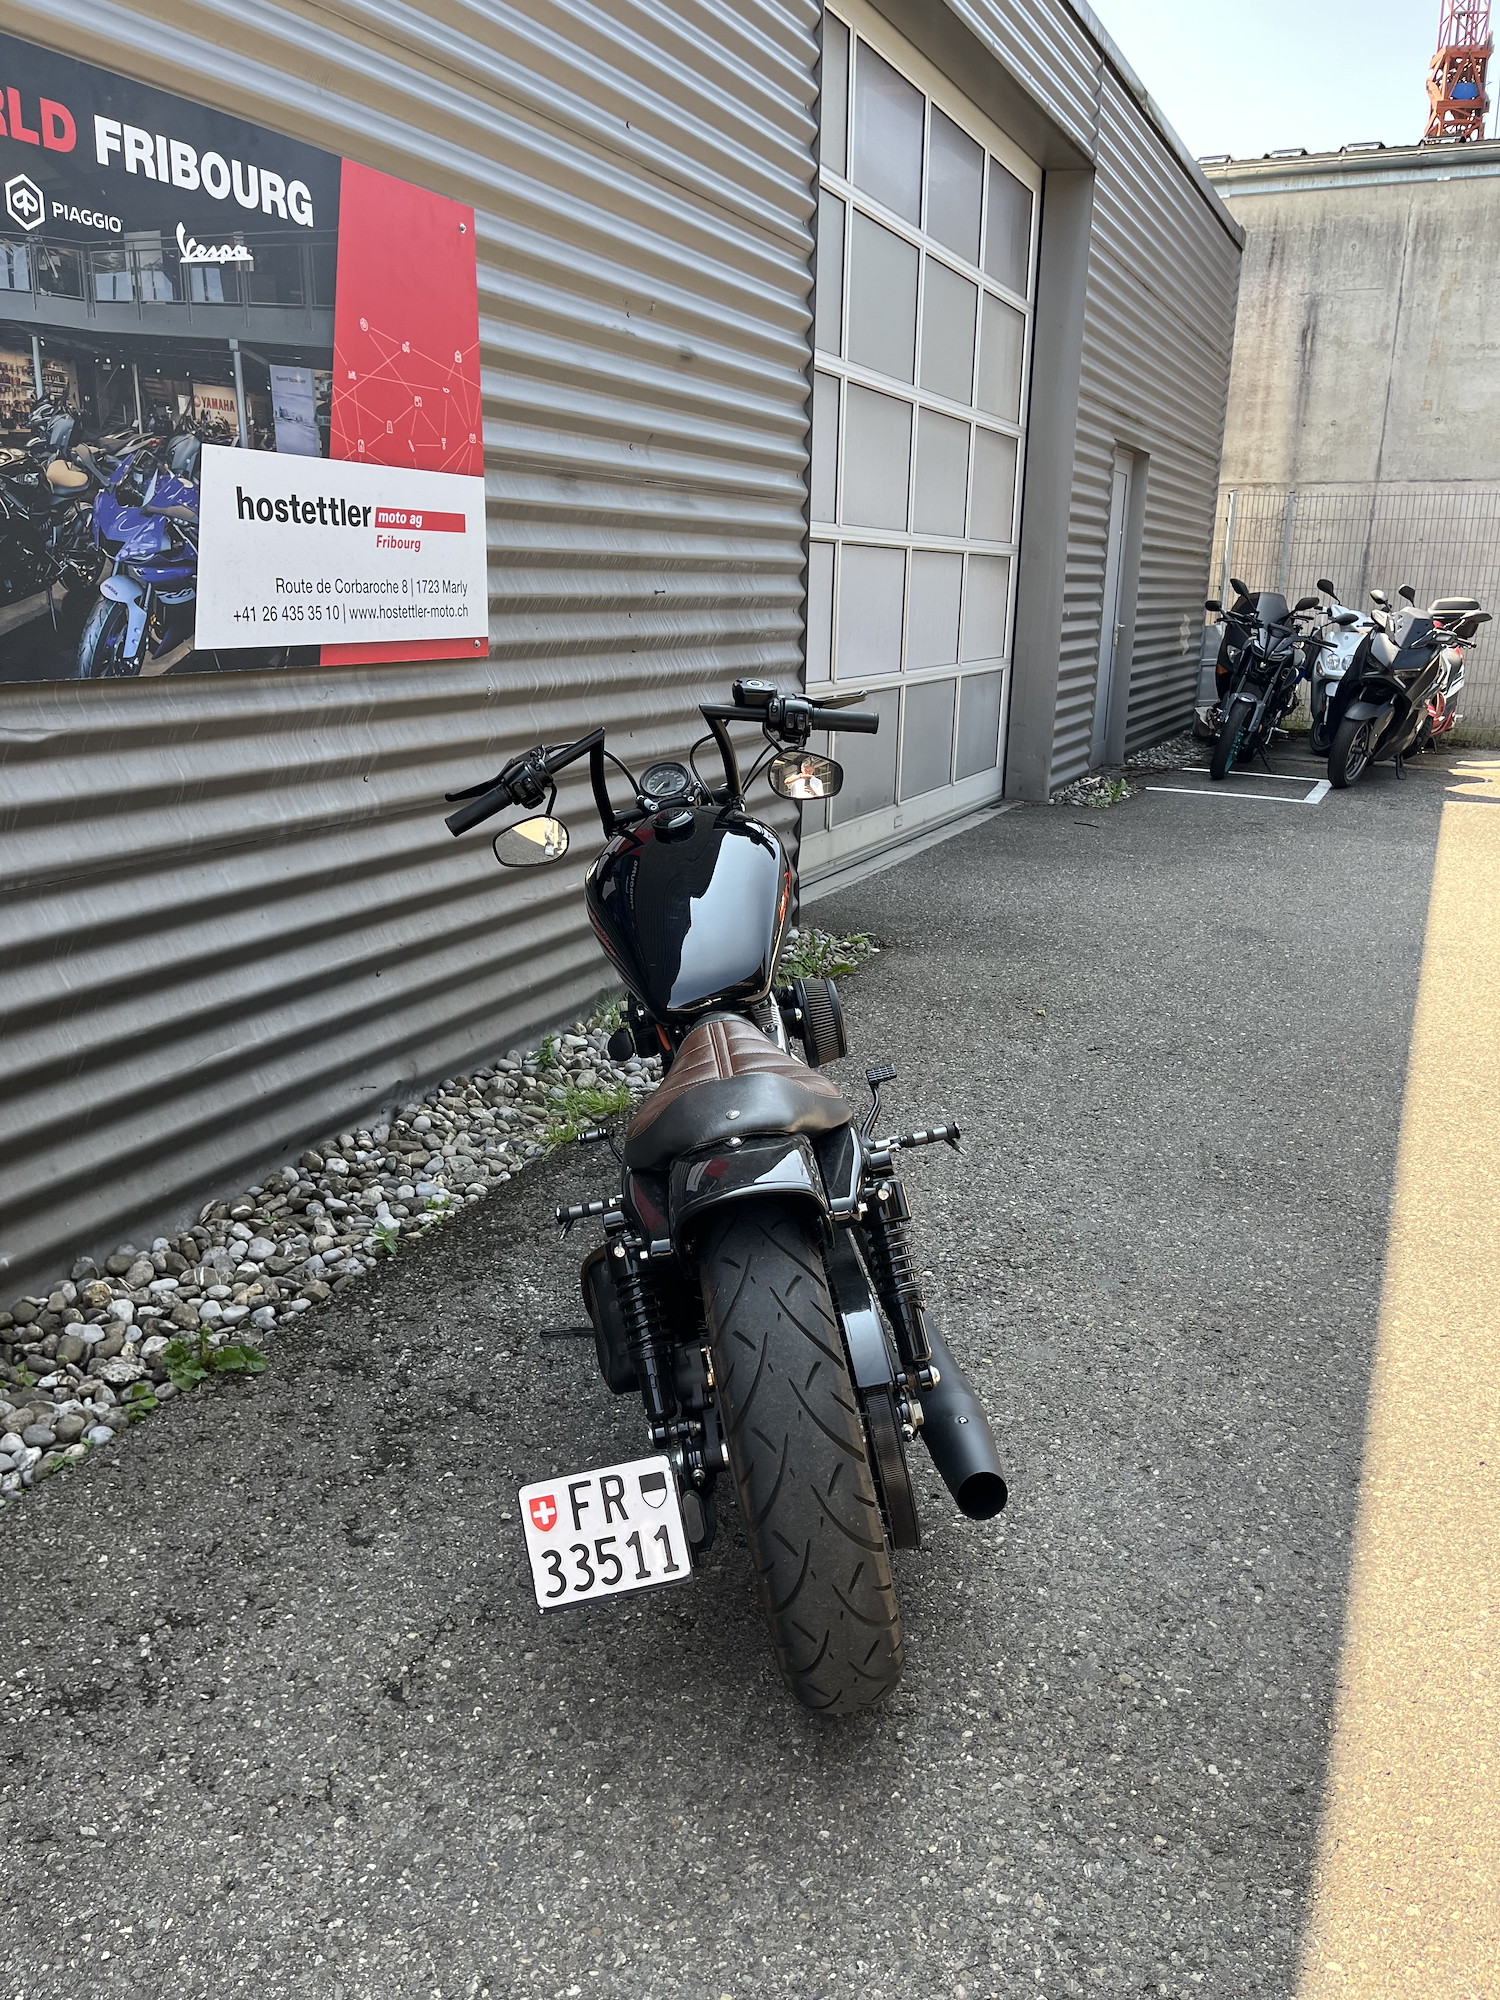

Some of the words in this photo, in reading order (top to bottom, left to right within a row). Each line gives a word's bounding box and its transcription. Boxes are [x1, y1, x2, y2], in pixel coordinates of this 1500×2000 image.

[0, 86, 77, 153] LD
[94, 114, 314, 228] FRIBOURG
[52, 201, 122, 233] PIAGGIO
[176, 221, 254, 264] Vespa
[201, 396, 235, 413] YAMAHA
[236, 486, 371, 527] hostettler
[378, 511, 406, 525] moto
[409, 514, 423, 528] ag
[376, 535, 421, 552] Fribourg
[275, 577, 313, 594] Route
[316, 578, 331, 594] de
[335, 578, 399, 594] Corbaroche
[401, 579, 408, 594] 8
[416, 579, 440, 594] 1723
[442, 579, 468, 597] Marly
[233, 606, 256, 622] +41
[262, 605, 278, 622] 26
[281, 605, 304, 621] 435
[307, 605, 322, 621] 35
[325, 605, 339, 620] 10
[349, 603, 469, 620] www.hostettler-moto.ch
[568, 1474, 629, 1531] FR
[541, 1524, 680, 1598] 33511
